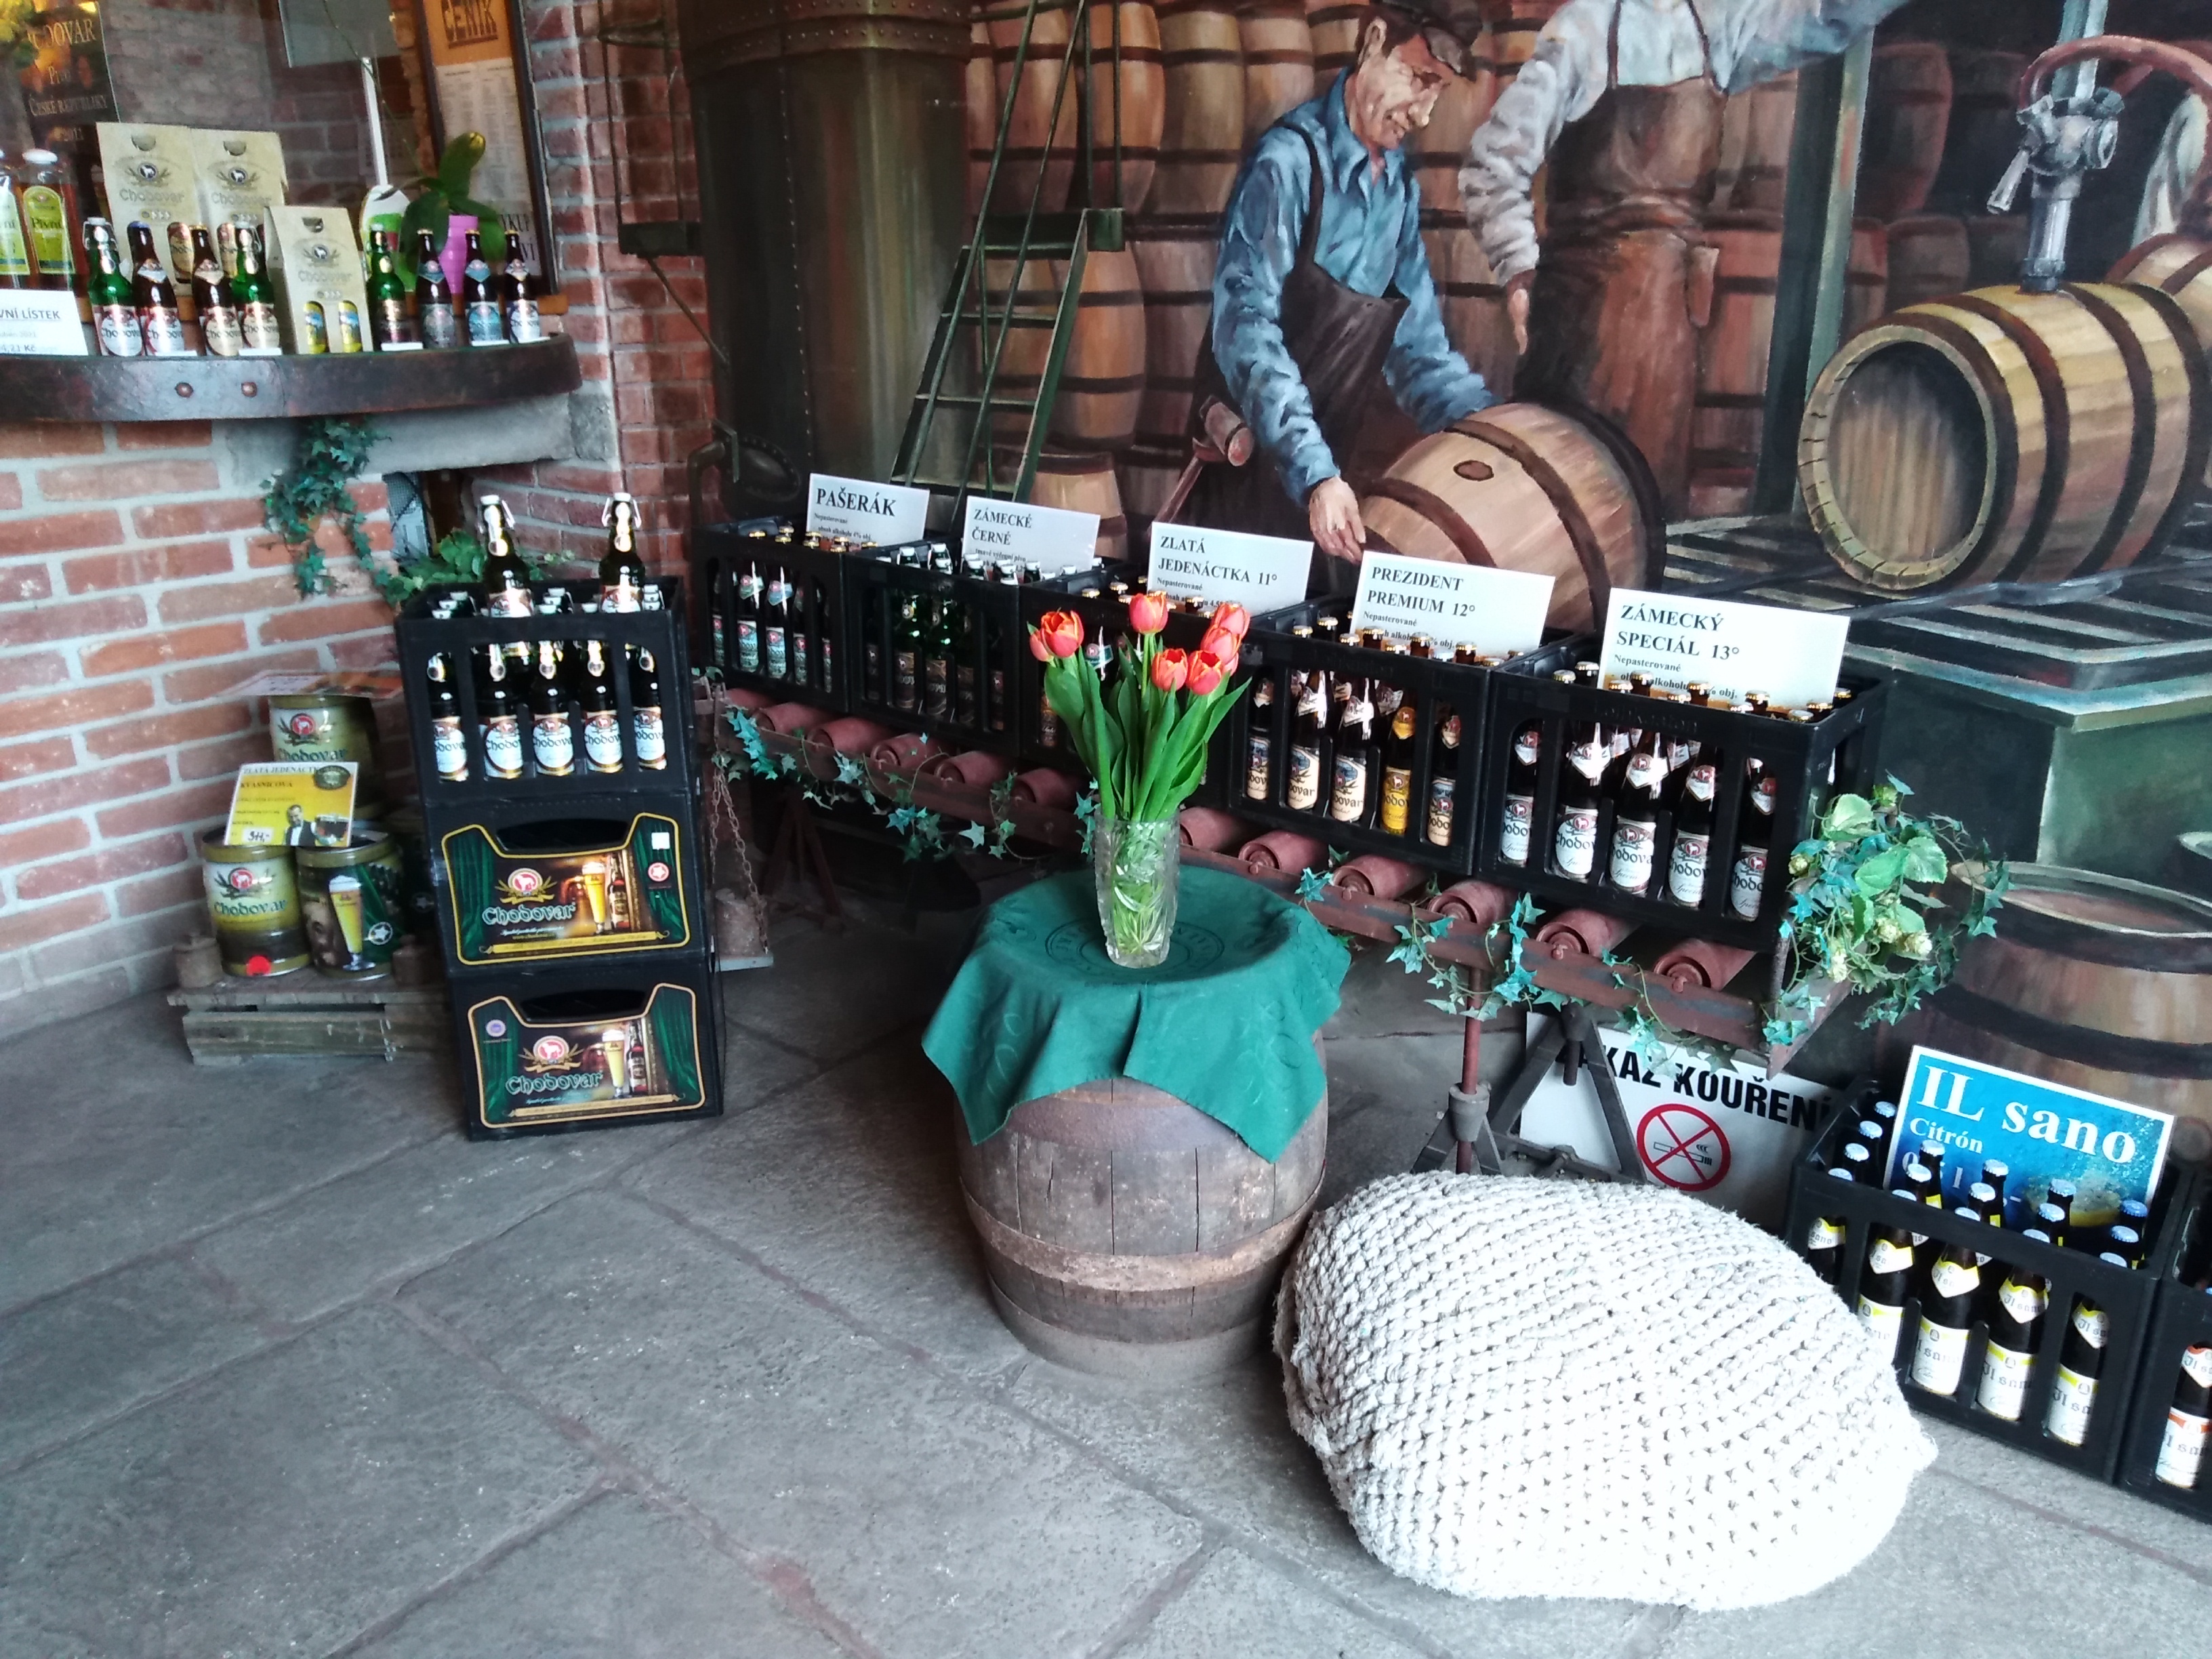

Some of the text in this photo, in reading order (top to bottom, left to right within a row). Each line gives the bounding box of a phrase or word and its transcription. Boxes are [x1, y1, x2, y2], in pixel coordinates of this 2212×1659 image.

[816, 486, 897, 516] PAŠERÁK
[974, 508, 1032, 529] ZÁMECKÉ
[972, 527, 1010, 546] ČERNÉ
[1160, 536, 1205, 554] ZLATÁ
[1157, 577, 1203, 590] Nepasterované
[1158, 558, 1277, 586] JEDENÁCTKA 11°
[1372, 567, 1464, 592] PREZIDENT
[1367, 590, 1475, 617] PREMIUM 12°
[1364, 611, 1417, 626] Nepasterované
[1620, 603, 1724, 631] ZÁMECKÝ
[1617, 631, 1740, 660] SPECIÁL 13°
[1614, 654, 1681, 672] Nepasterované
[1719, 688, 1738, 699] obj.
[214, 900, 287, 916] Chodovar
[482, 902, 575, 926] Chodovar
[506, 1071, 602, 1096] Chodovar
[1916, 1065, 2136, 1164] IL sano
[1909, 1118, 1983, 1154] Citrón
